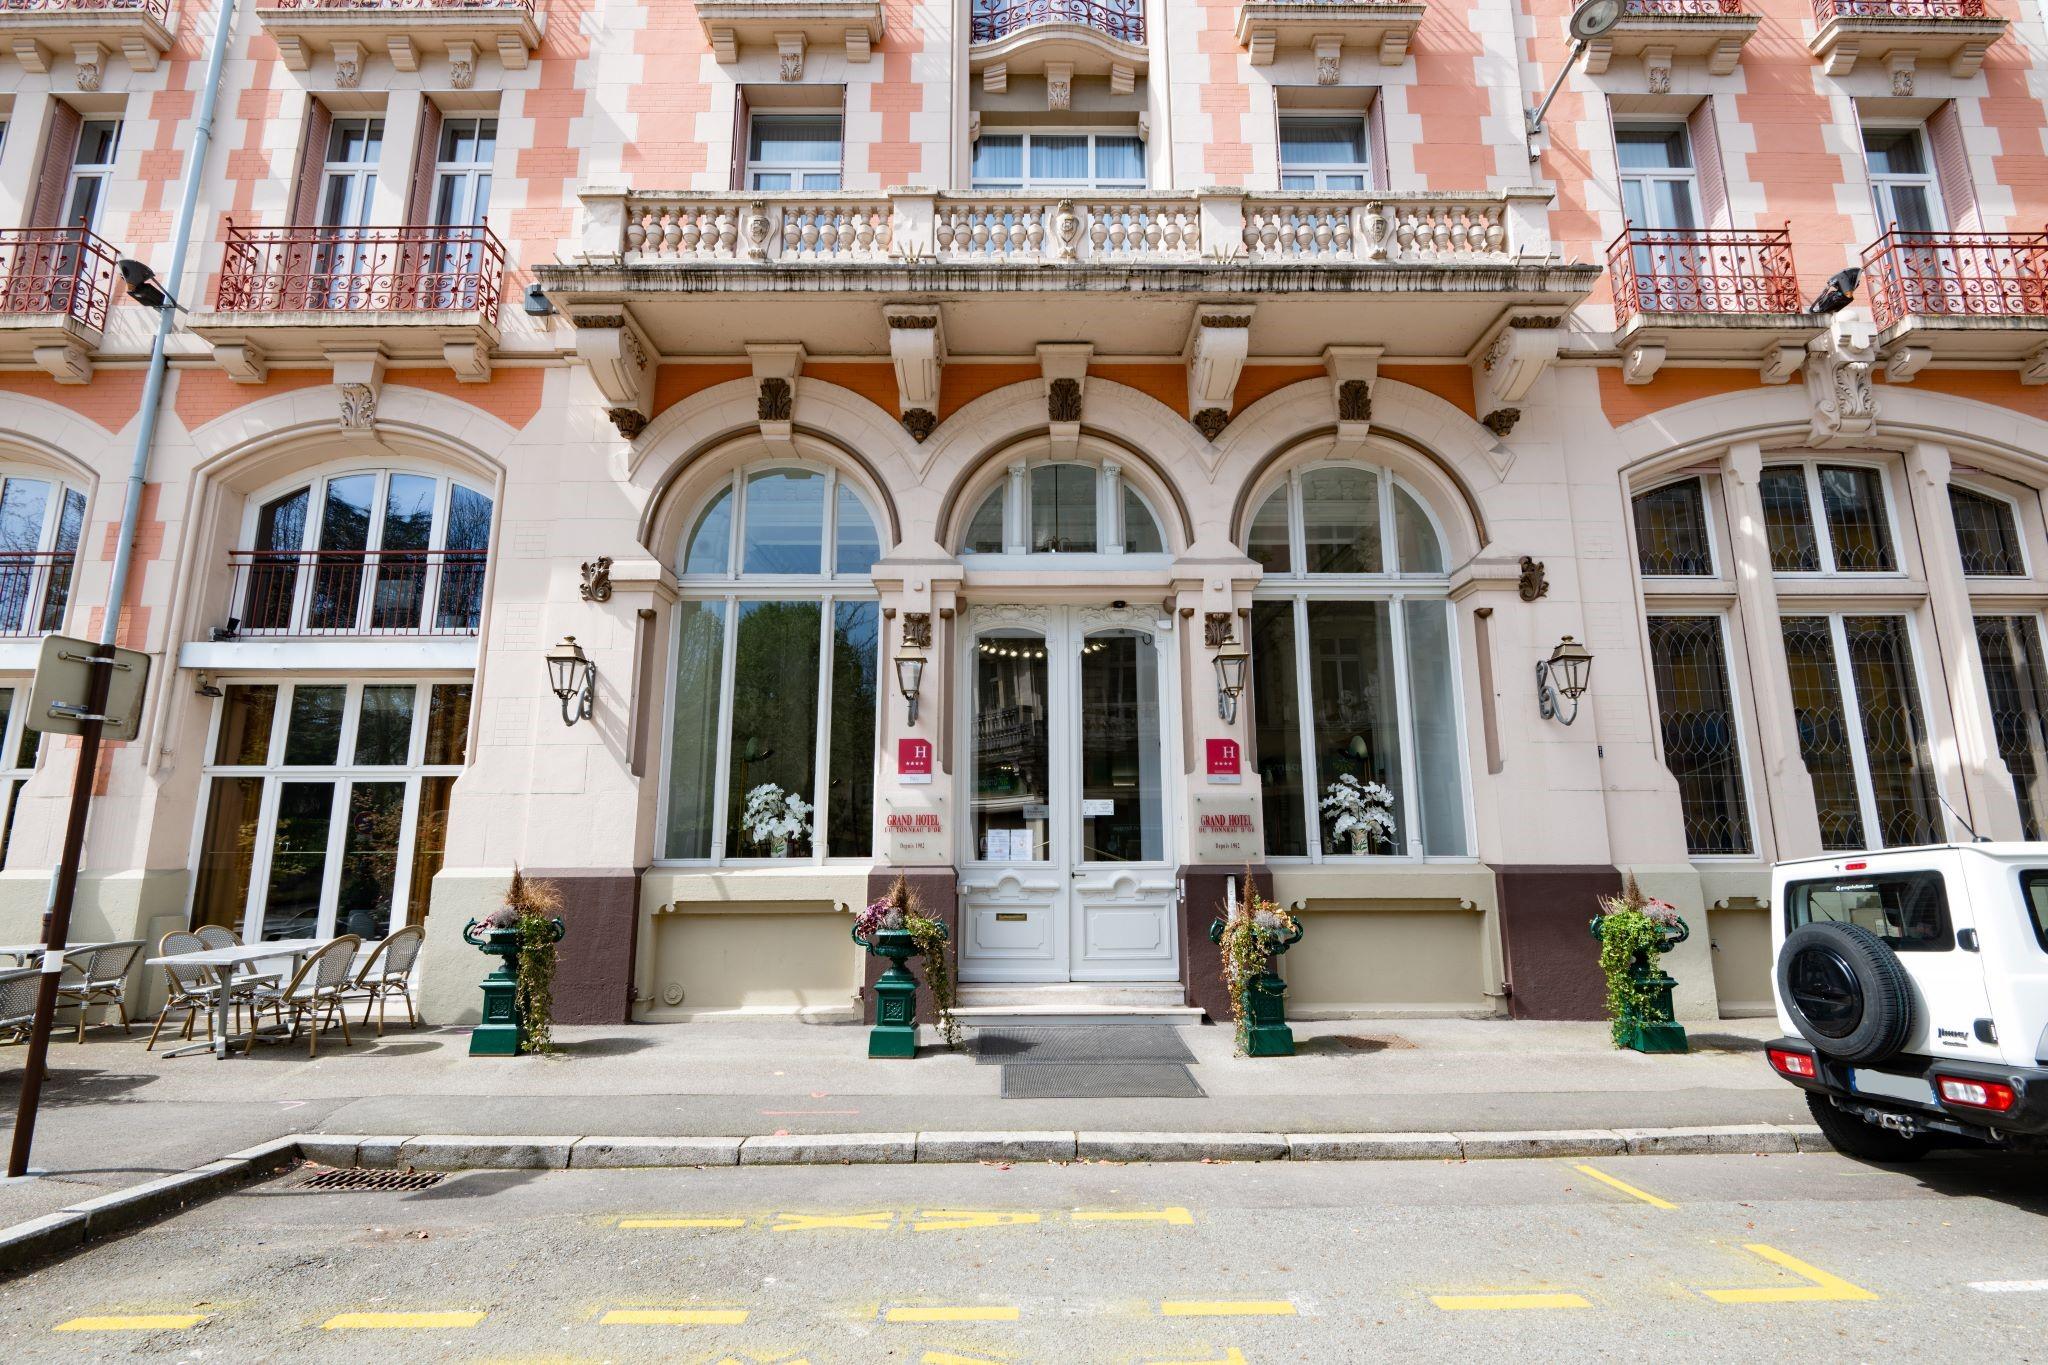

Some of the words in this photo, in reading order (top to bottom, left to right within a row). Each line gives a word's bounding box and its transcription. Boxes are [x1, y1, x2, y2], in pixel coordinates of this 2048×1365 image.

[914, 746, 927, 758] H
[1223, 746, 1235, 758] H
[887, 815, 912, 825] GRAND
[915, 815, 939, 825] HOTEL
[1201, 815, 1225, 825] GRAND
[1229, 815, 1252, 825] HOTEL
